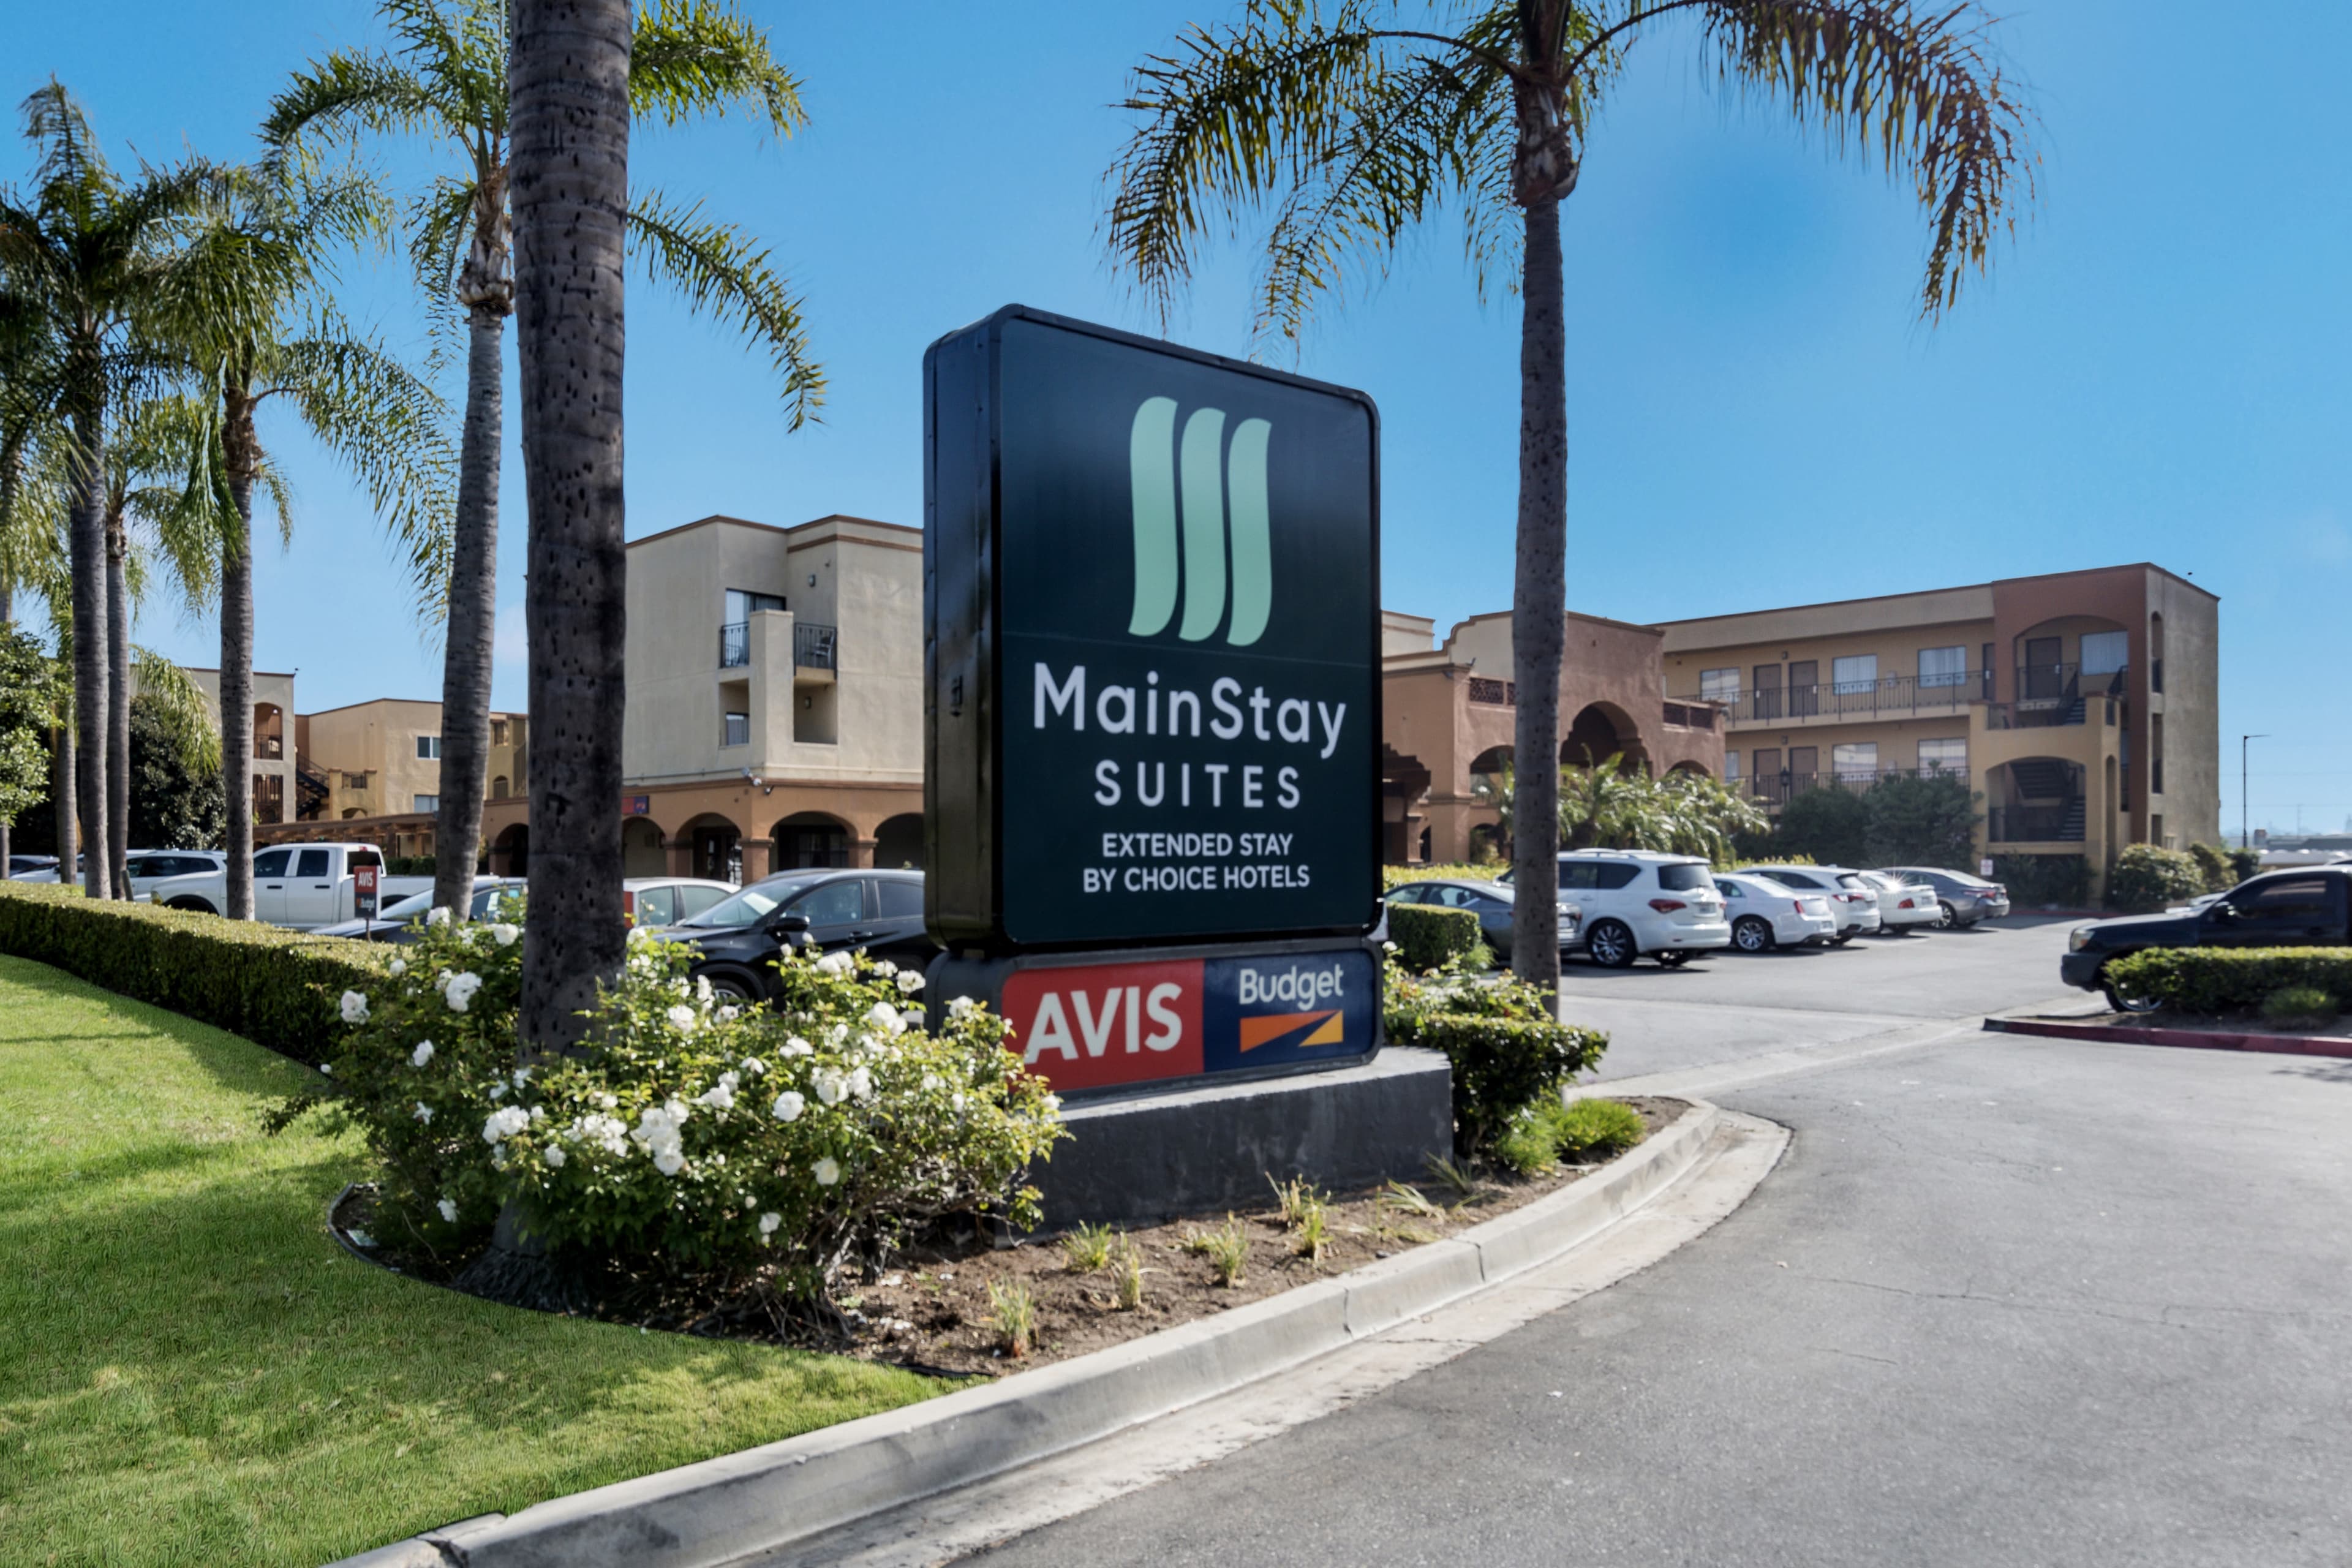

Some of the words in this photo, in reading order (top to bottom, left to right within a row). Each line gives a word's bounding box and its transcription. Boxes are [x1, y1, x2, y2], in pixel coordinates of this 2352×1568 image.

[1034, 662, 1346, 759] MainStay
[1095, 760, 1300, 809] SUITES
[1102, 833, 1232, 857] EXTENDED
[1239, 833, 1293, 856] STAY
[358, 871, 373, 887] AVIS
[1084, 869, 1117, 892] BY
[1125, 867, 1216, 892] CHOICE
[1224, 864, 1310, 889] HOTELS
[1239, 963, 1344, 1011] Budget
[1023, 982, 1183, 1064] AVIS
